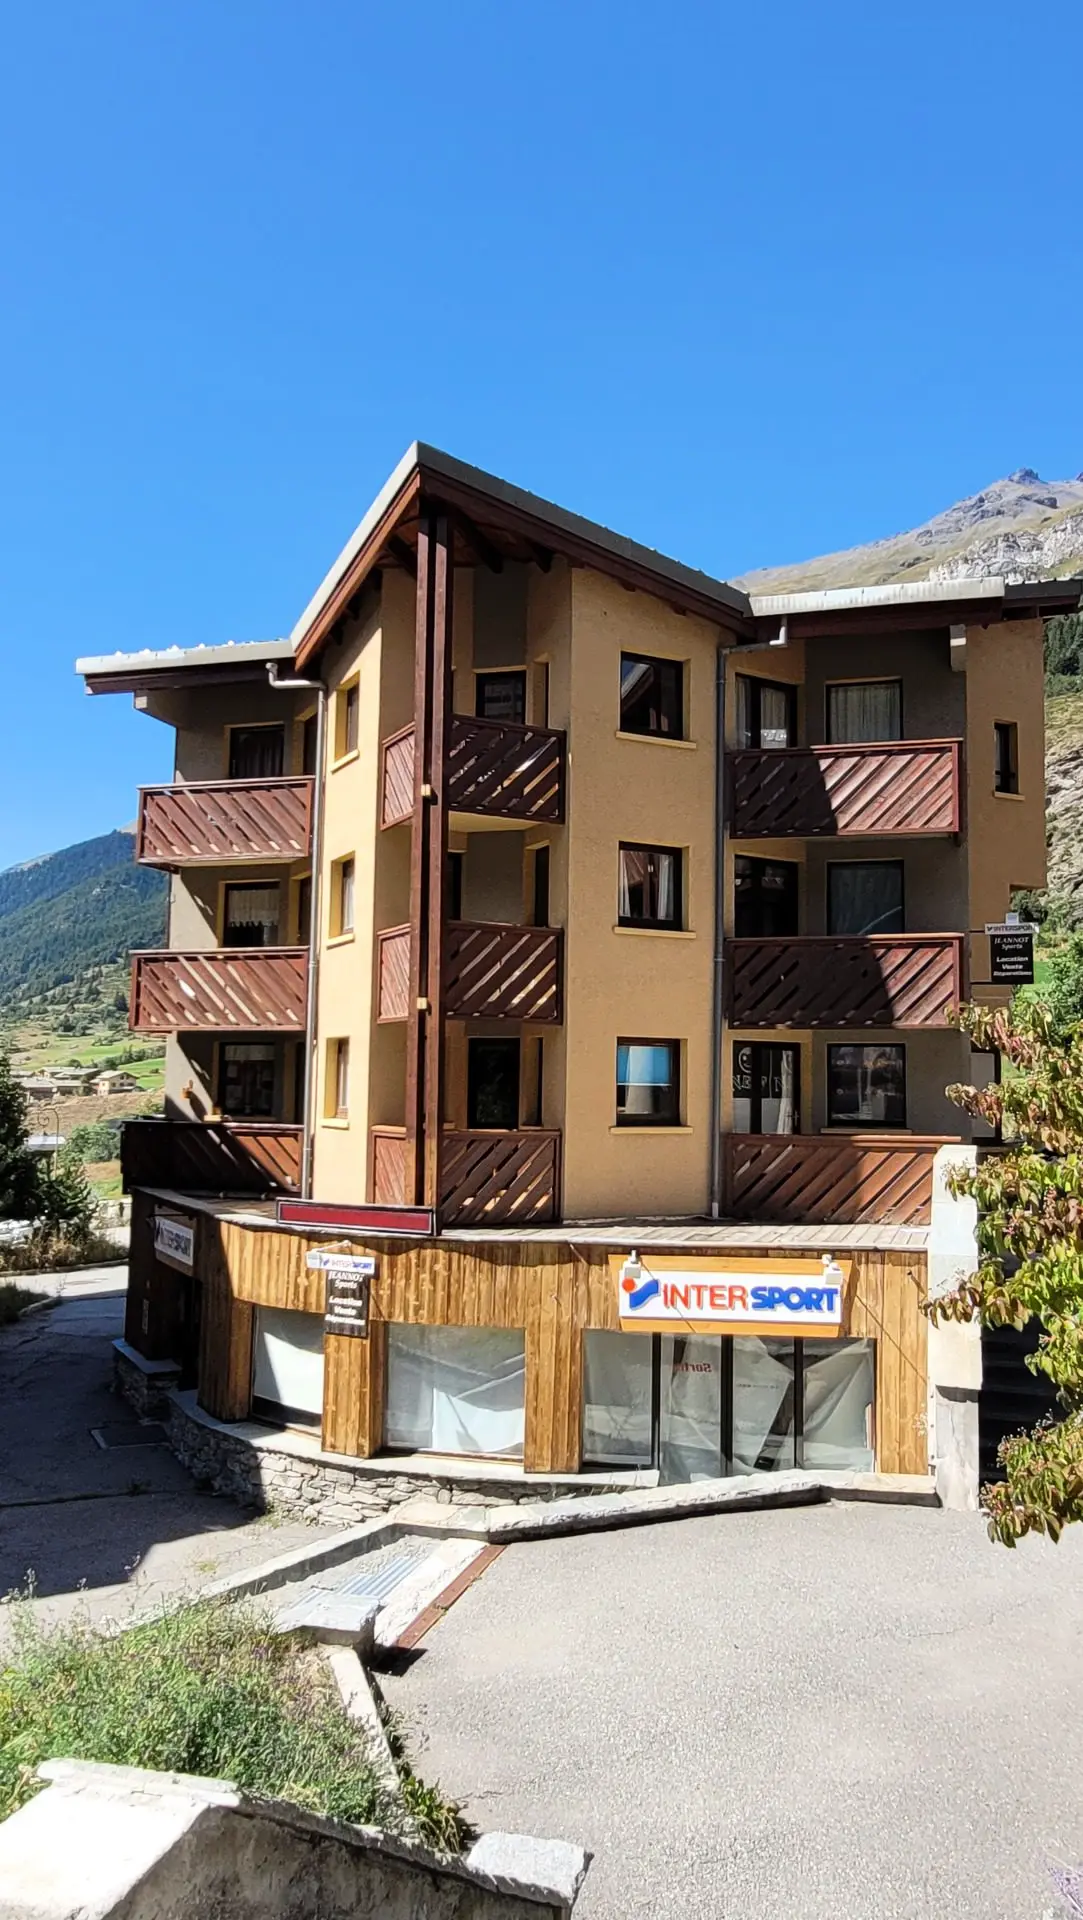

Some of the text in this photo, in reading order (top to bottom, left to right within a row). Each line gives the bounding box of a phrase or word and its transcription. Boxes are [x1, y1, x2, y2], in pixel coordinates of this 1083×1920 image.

[994, 936, 1030, 945] JEANNOT
[1001, 943, 1023, 951] Sports
[334, 1279, 358, 1290] Sports
[661, 1283, 839, 1313] INTERSPORT
